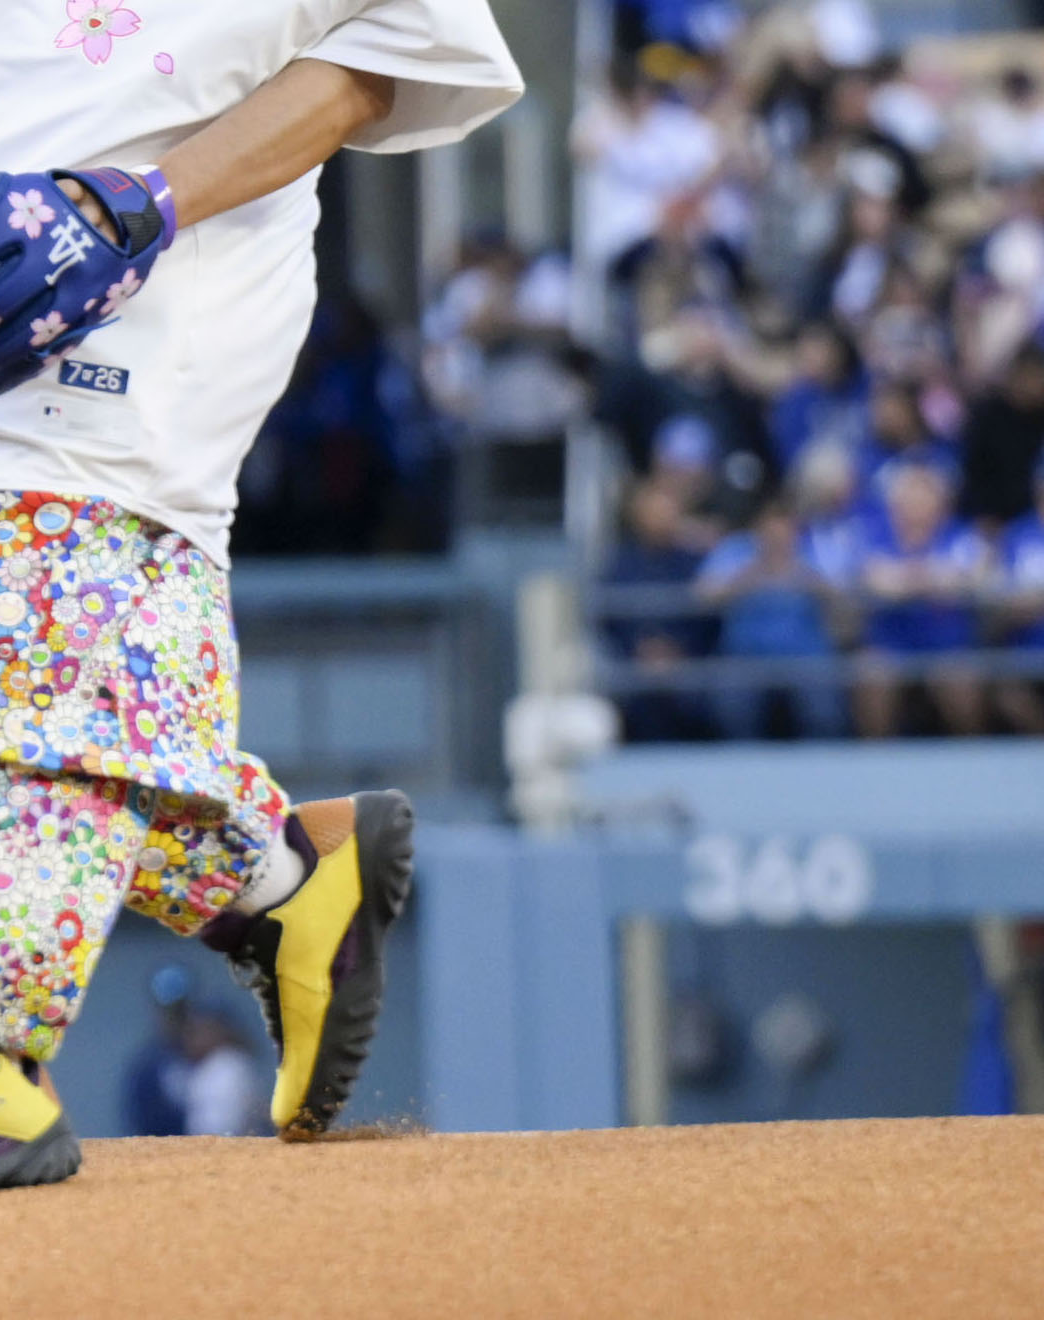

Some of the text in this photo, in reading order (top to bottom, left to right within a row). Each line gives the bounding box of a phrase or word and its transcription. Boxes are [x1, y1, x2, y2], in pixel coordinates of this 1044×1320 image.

[67, 361, 83, 384] 7
[94, 366, 123, 391] 26
[683, 833, 875, 927] 360
